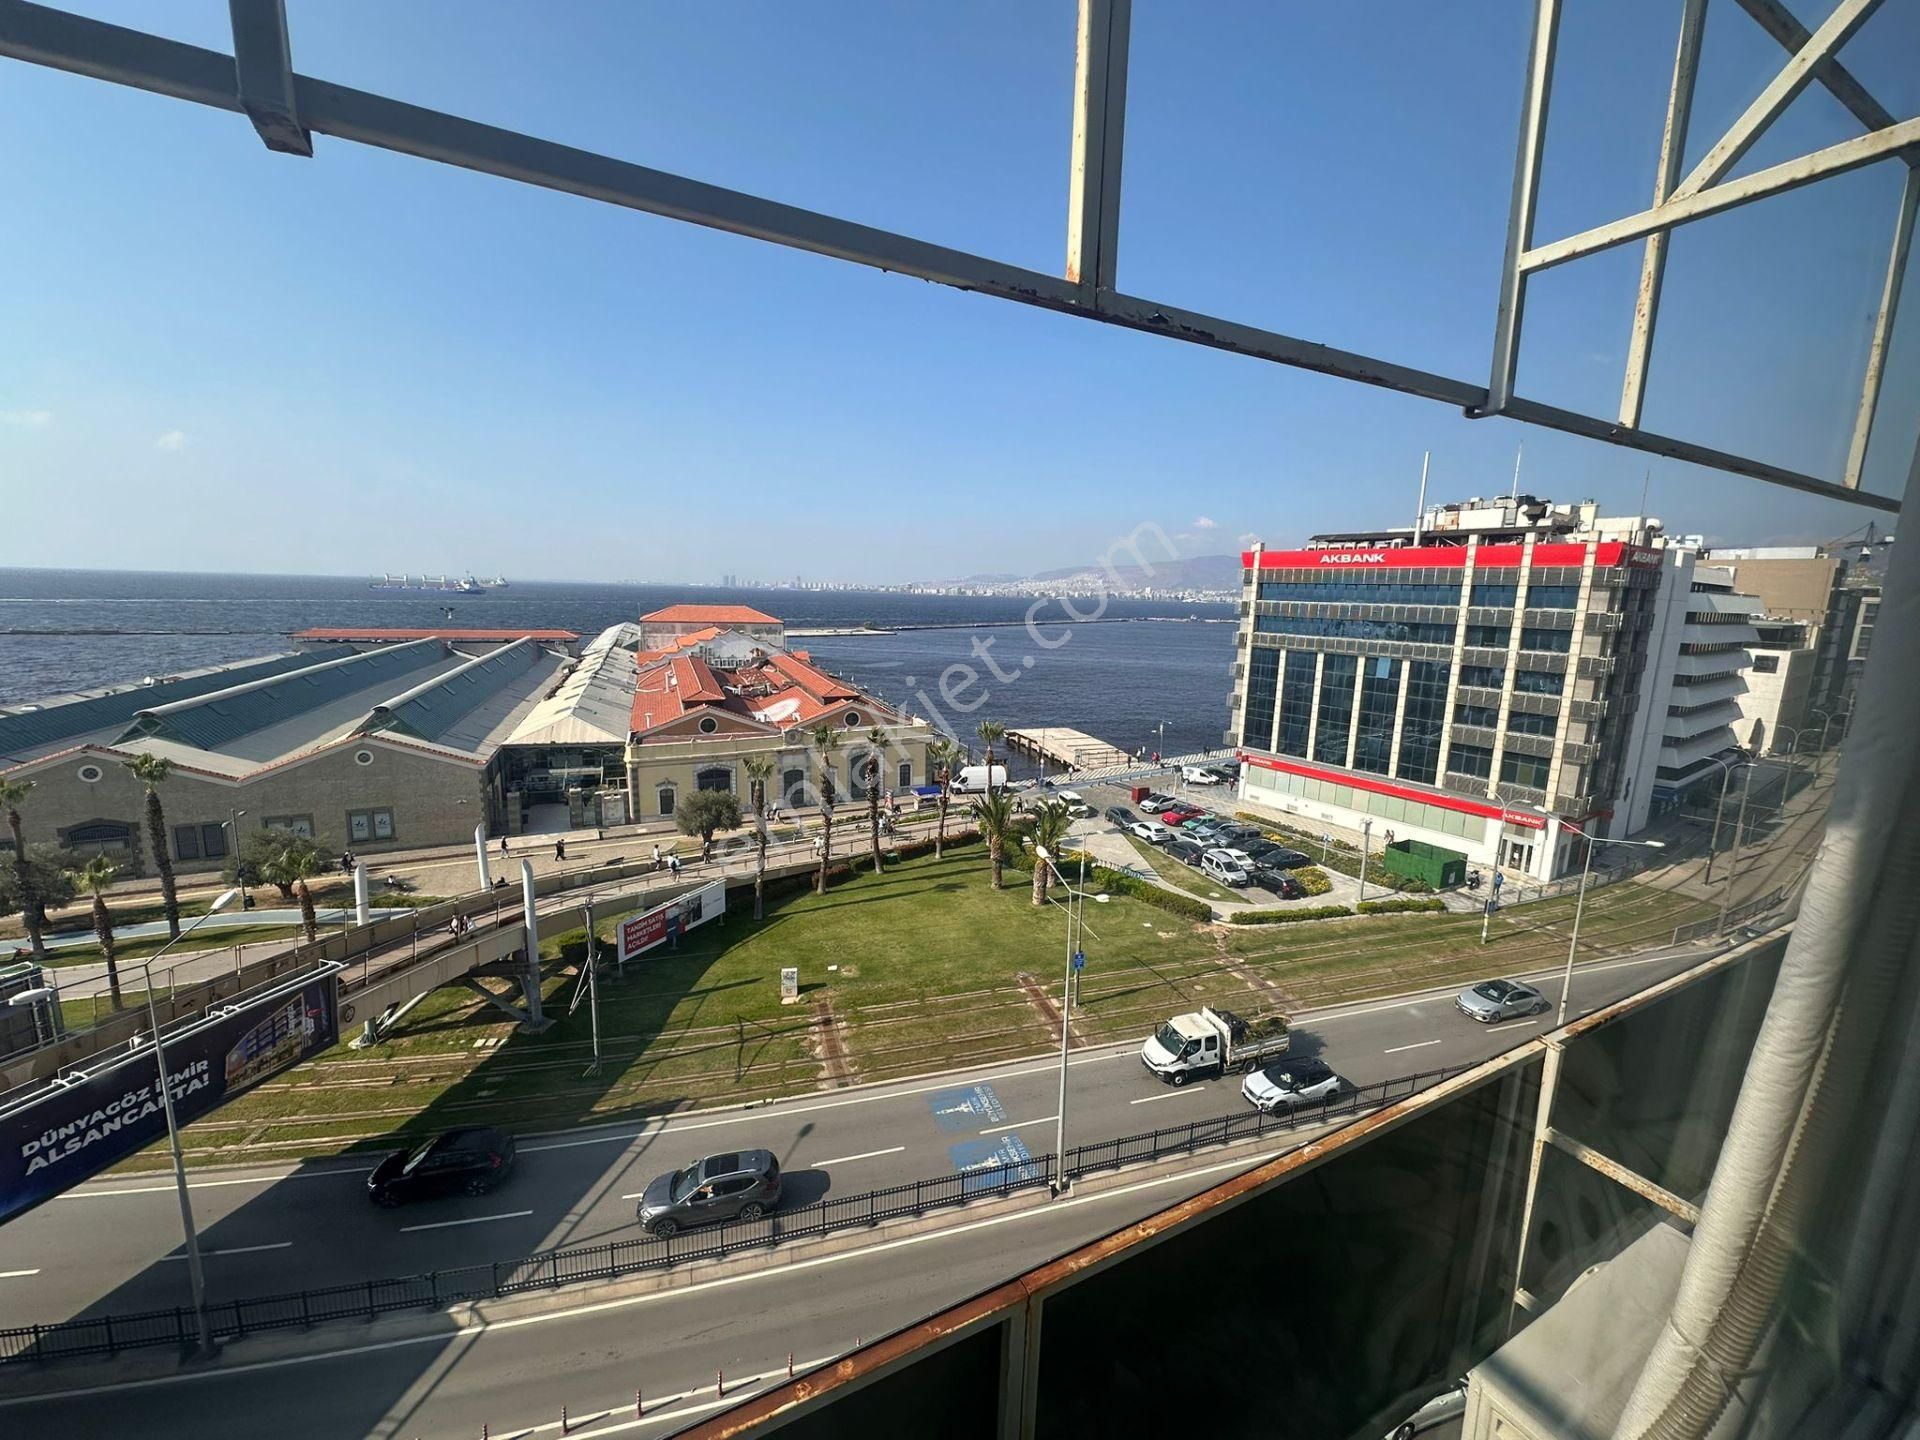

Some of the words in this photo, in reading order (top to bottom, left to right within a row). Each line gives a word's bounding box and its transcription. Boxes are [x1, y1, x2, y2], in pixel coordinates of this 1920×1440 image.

[1320, 553, 1385, 563] AKBANK
[1504, 813, 1545, 825] AKBANK
[22, 1087, 151, 1158] DÜNYAGÖZ
[155, 1060, 209, 1093] İZMİR
